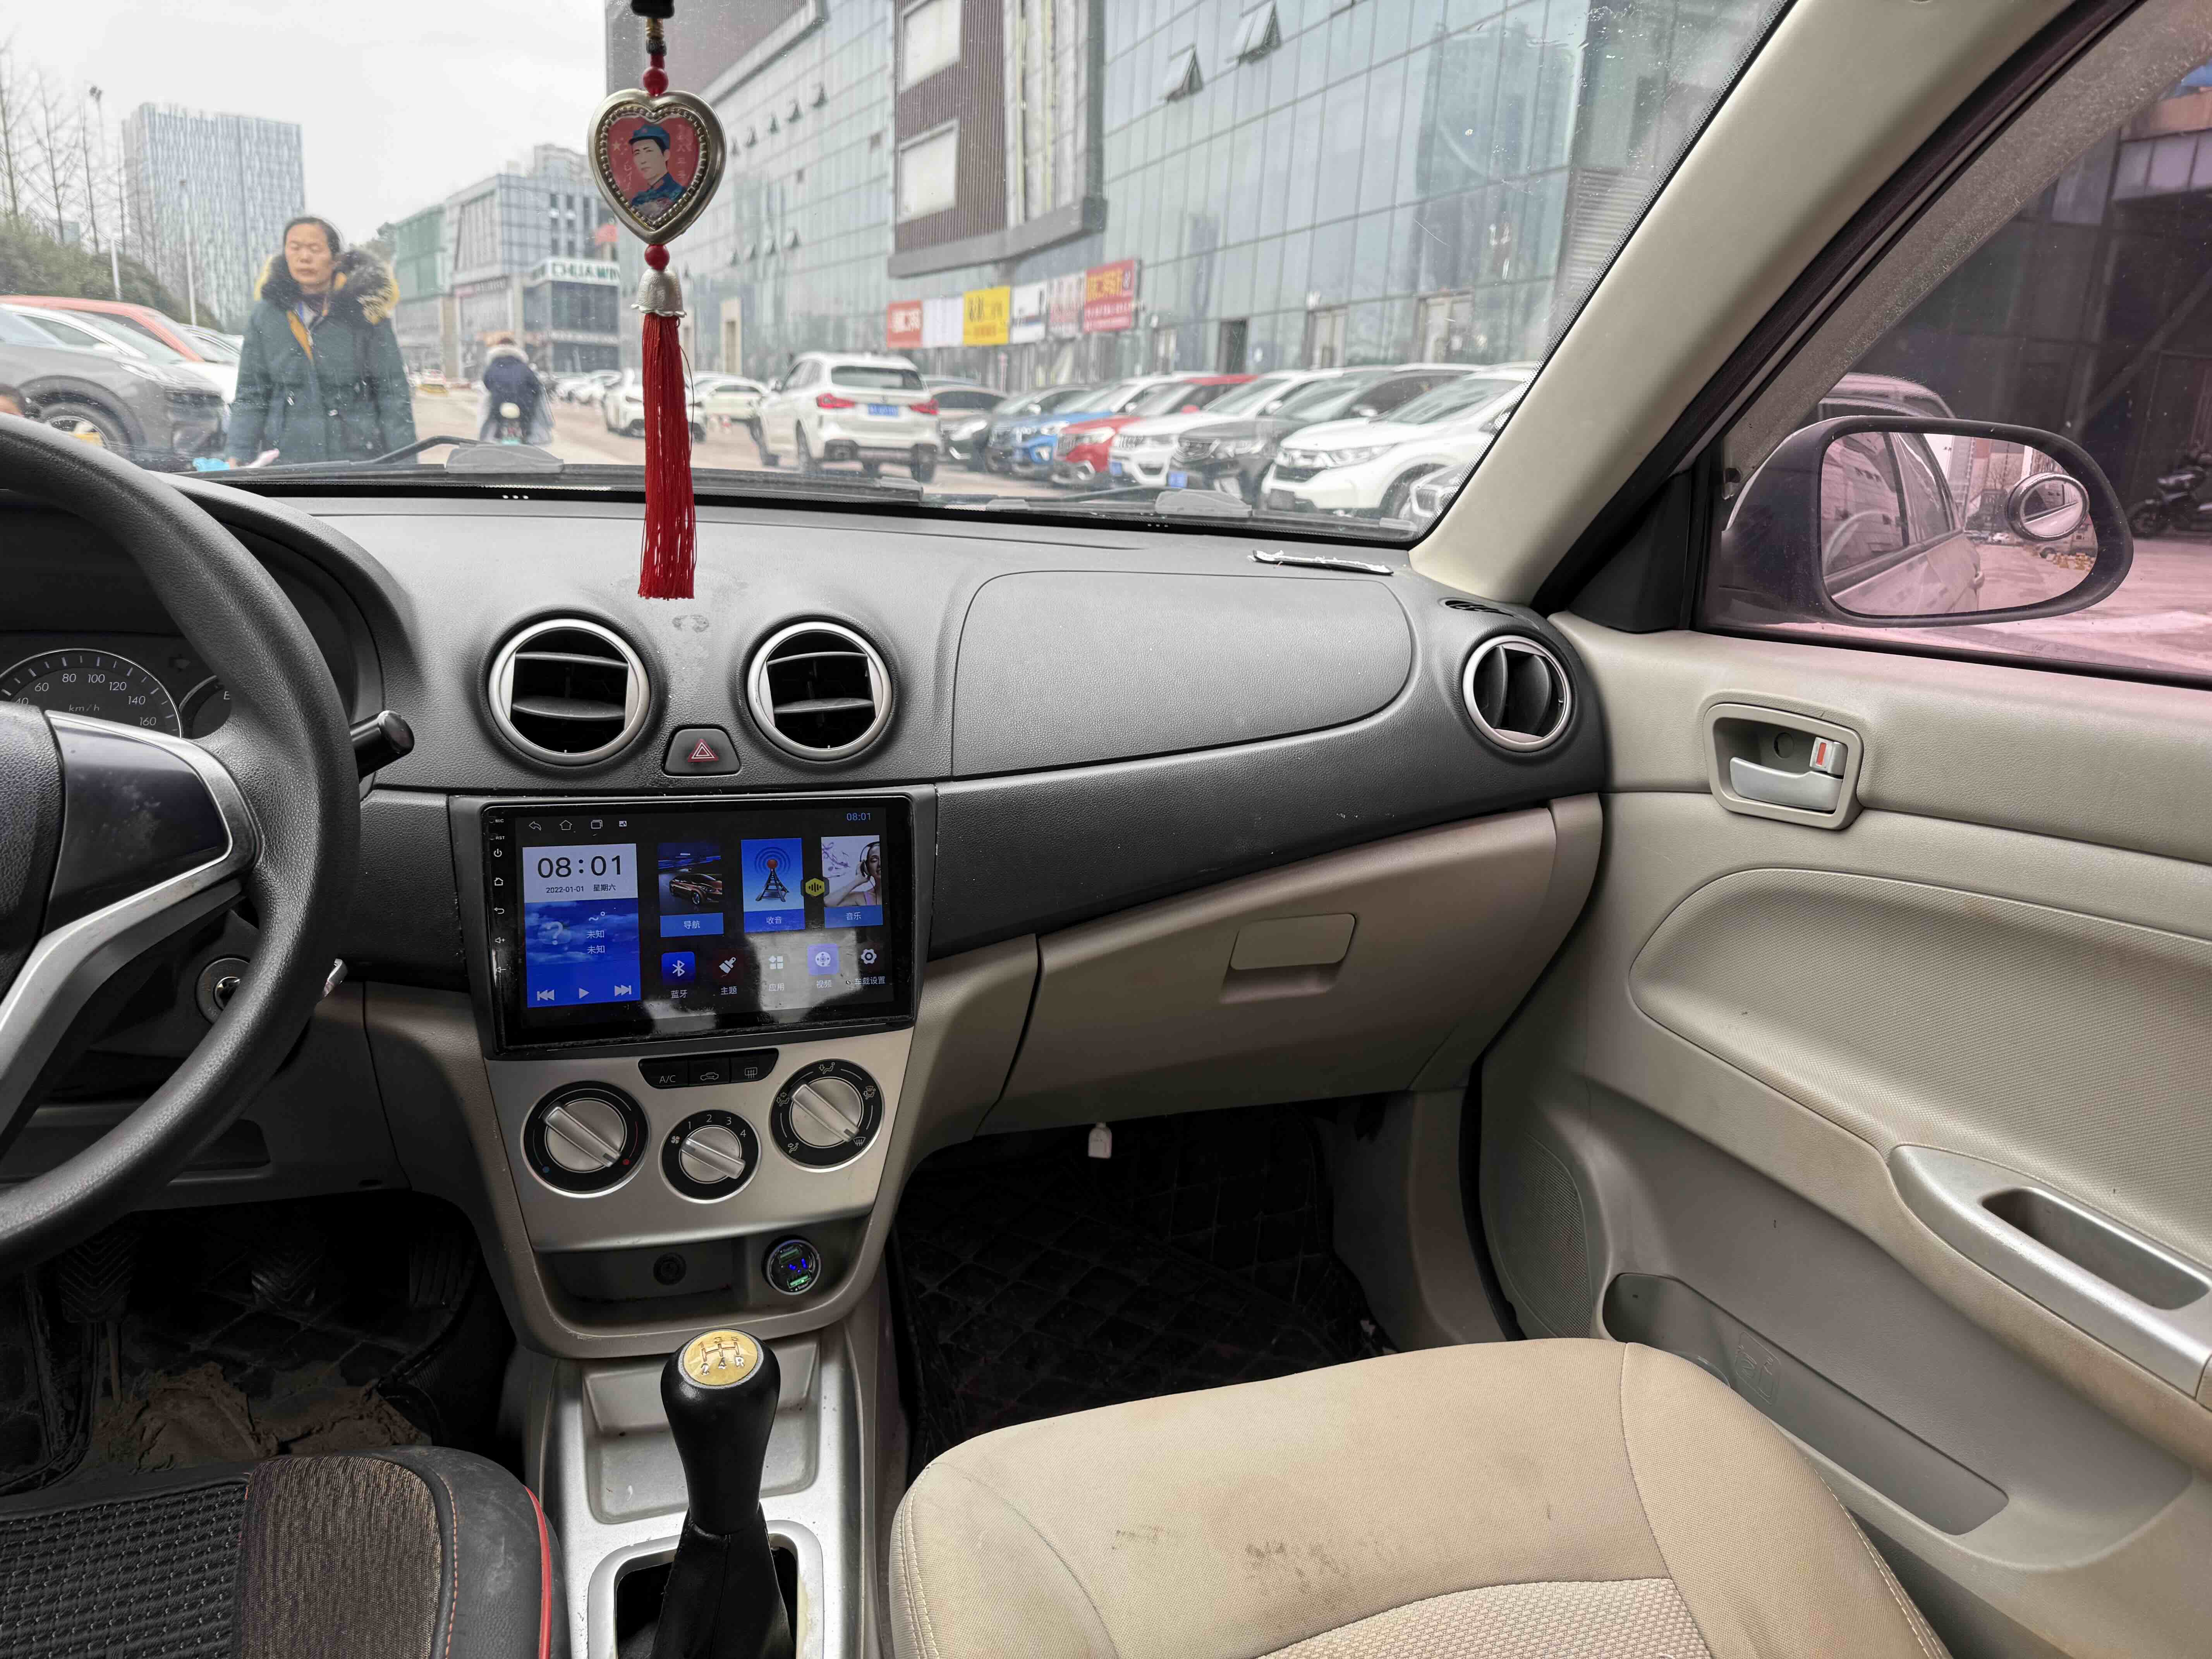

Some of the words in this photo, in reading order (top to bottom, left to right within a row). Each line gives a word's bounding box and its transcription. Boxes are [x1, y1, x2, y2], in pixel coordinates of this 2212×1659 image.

[62, 673, 76, 683] 80
[88, 674, 105, 684] 100
[34, 682, 49, 692] 60
[109, 681, 127, 691] 120
[128, 695, 146, 705] 140
[69, 704, 100, 712] km/h
[139, 716, 156, 726] 160
[847, 812, 871, 821] 08:01
[537, 855, 621, 879] 08:01
[593, 884, 617, 892] 星期六
[766, 916, 783, 924] 收音
[845, 912, 862, 921] 音乐
[683, 920, 701, 929] 导航
[586, 929, 605, 938] 未知
[587, 945, 605, 954] 未知
[670, 989, 688, 999] 蓝牙
[720, 986, 737, 995] 主题
[687, 1121, 692, 1130] 1
[706, 1114, 712, 1123] 2
[726, 1116, 732, 1125] 3
[734, 1356, 744, 1367] R
